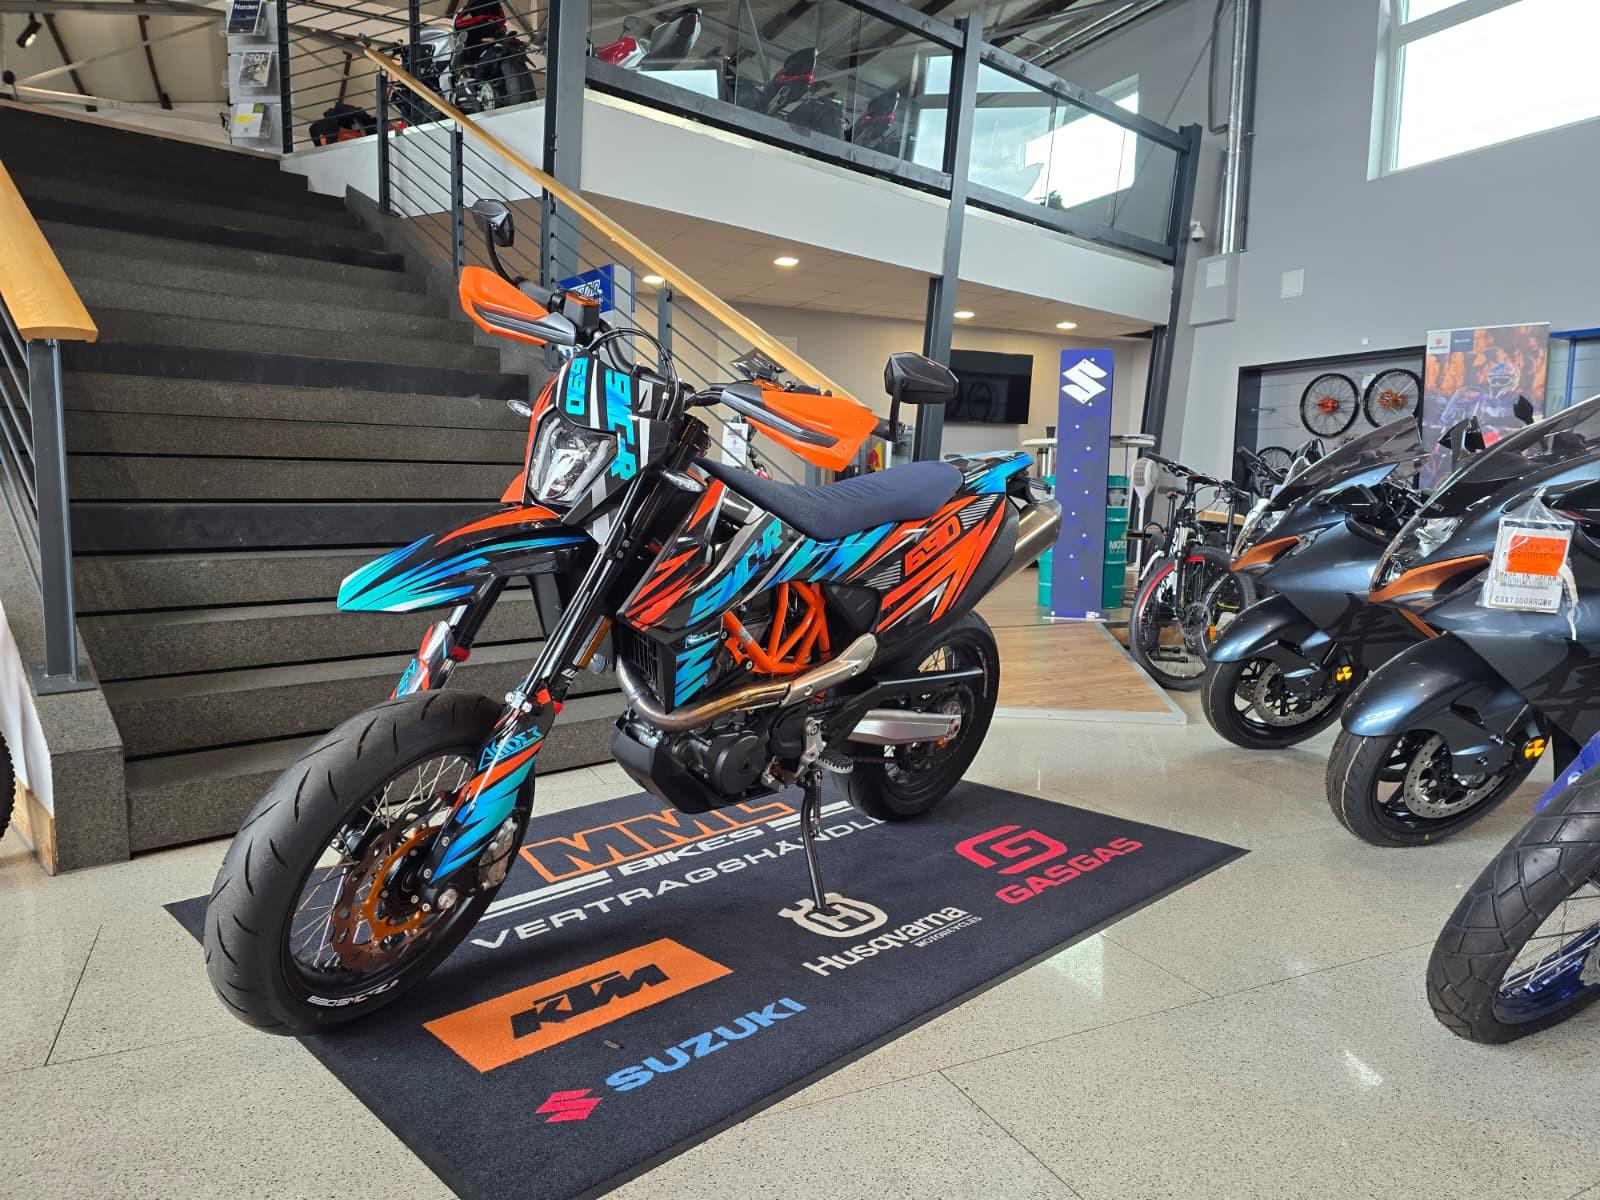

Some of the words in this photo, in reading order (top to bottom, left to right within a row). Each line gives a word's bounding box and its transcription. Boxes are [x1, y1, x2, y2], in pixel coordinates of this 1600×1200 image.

[566, 357, 589, 416] 690
[904, 515, 961, 577] 690
[616, 823, 766, 877] BIKES
[994, 837, 1144, 905] GASGAS
[802, 906, 969, 977] Husqvarna
[915, 915, 983, 948] MOTORCYCLES
[510, 962, 671, 1040] KTM
[605, 996, 808, 1093] SUZUKI
